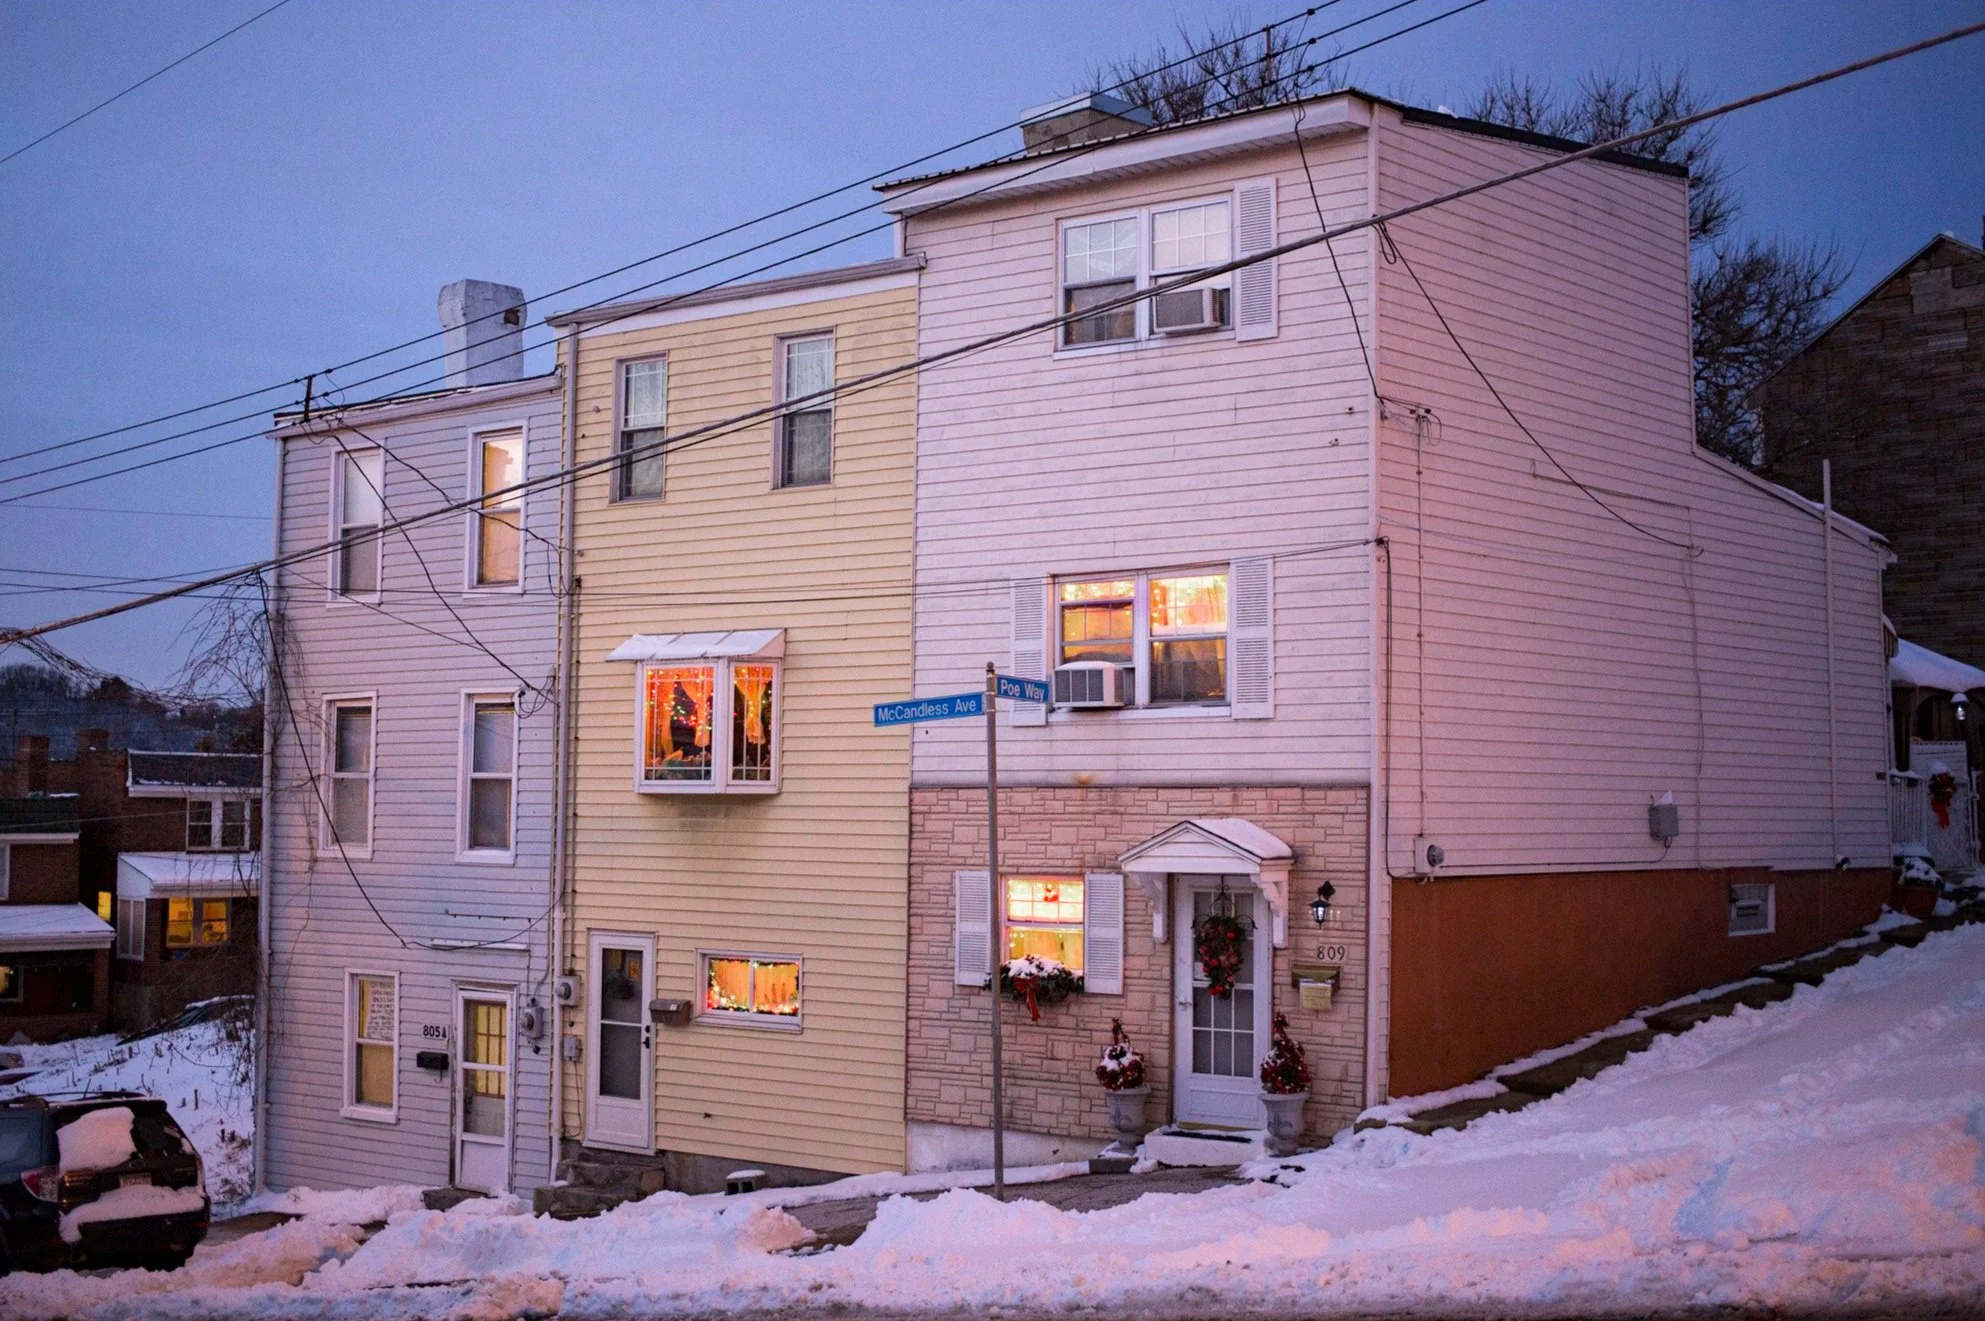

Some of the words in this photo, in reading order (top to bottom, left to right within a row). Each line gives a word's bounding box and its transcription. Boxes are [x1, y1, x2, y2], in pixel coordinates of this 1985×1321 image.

[1000, 679, 1021, 697] Poe
[1023, 682, 1045, 702] Way
[877, 702, 949, 722] McCandless
[954, 698, 977, 713] Ave
[1317, 945, 1345, 960] 809
